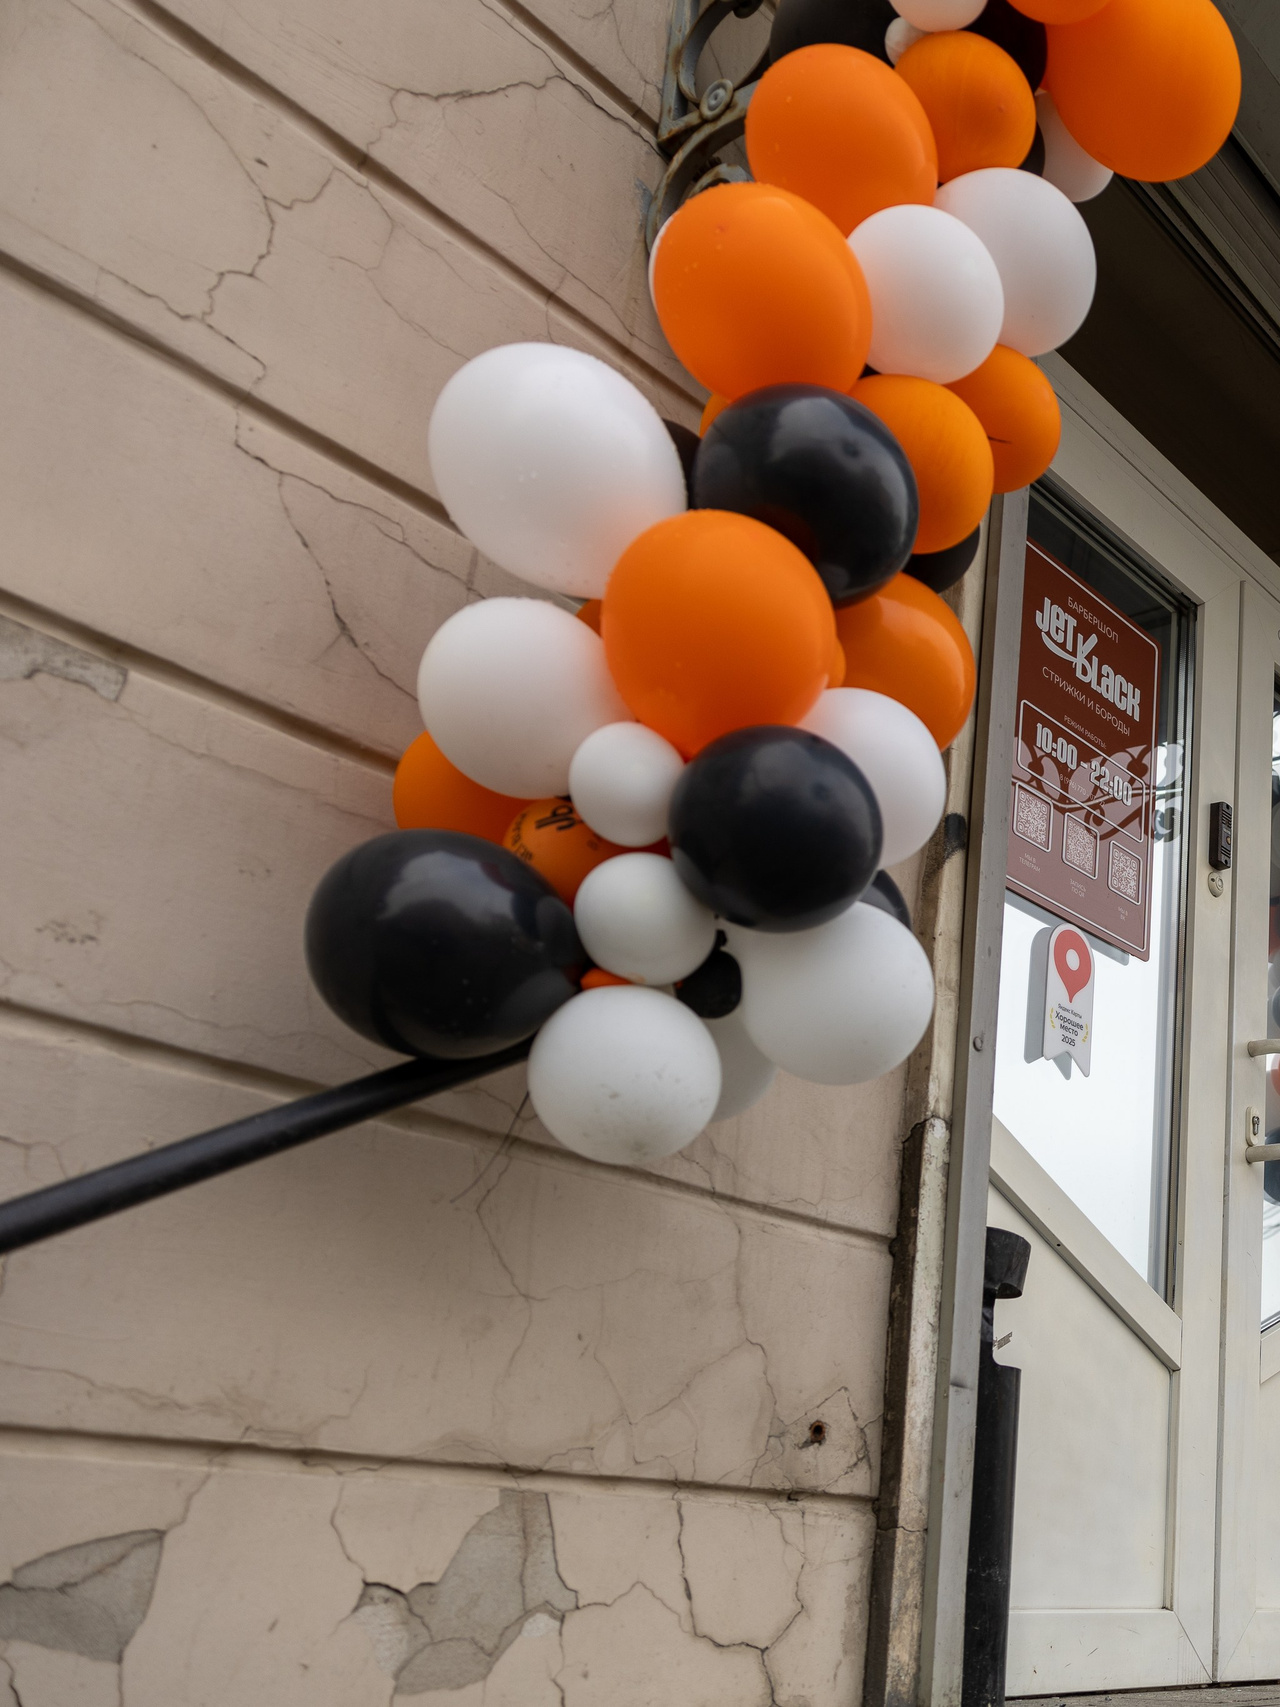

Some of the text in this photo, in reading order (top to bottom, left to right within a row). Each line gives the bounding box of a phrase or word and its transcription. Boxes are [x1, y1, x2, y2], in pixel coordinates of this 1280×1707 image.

[1067, 596, 1119, 643] БАРБЕРШОП
[1042, 666, 1131, 737] СТРИЖКИ И БОРОДЫ
[1063, 714, 1107, 750] РЕЖИМ РАБОТЫ:
[1036, 722, 1078, 770] 10:00
[1090, 760, 1133, 806] 22:00
[1019, 856, 1041, 873] ТЕЛЕГРАМ
[1069, 878, 1087, 893] ЗАПИСЬ
[1055, 1010, 1084, 1030] Хорошее
[1060, 1023, 1079, 1037] место
[1061, 1034, 1076, 1047] 2025
